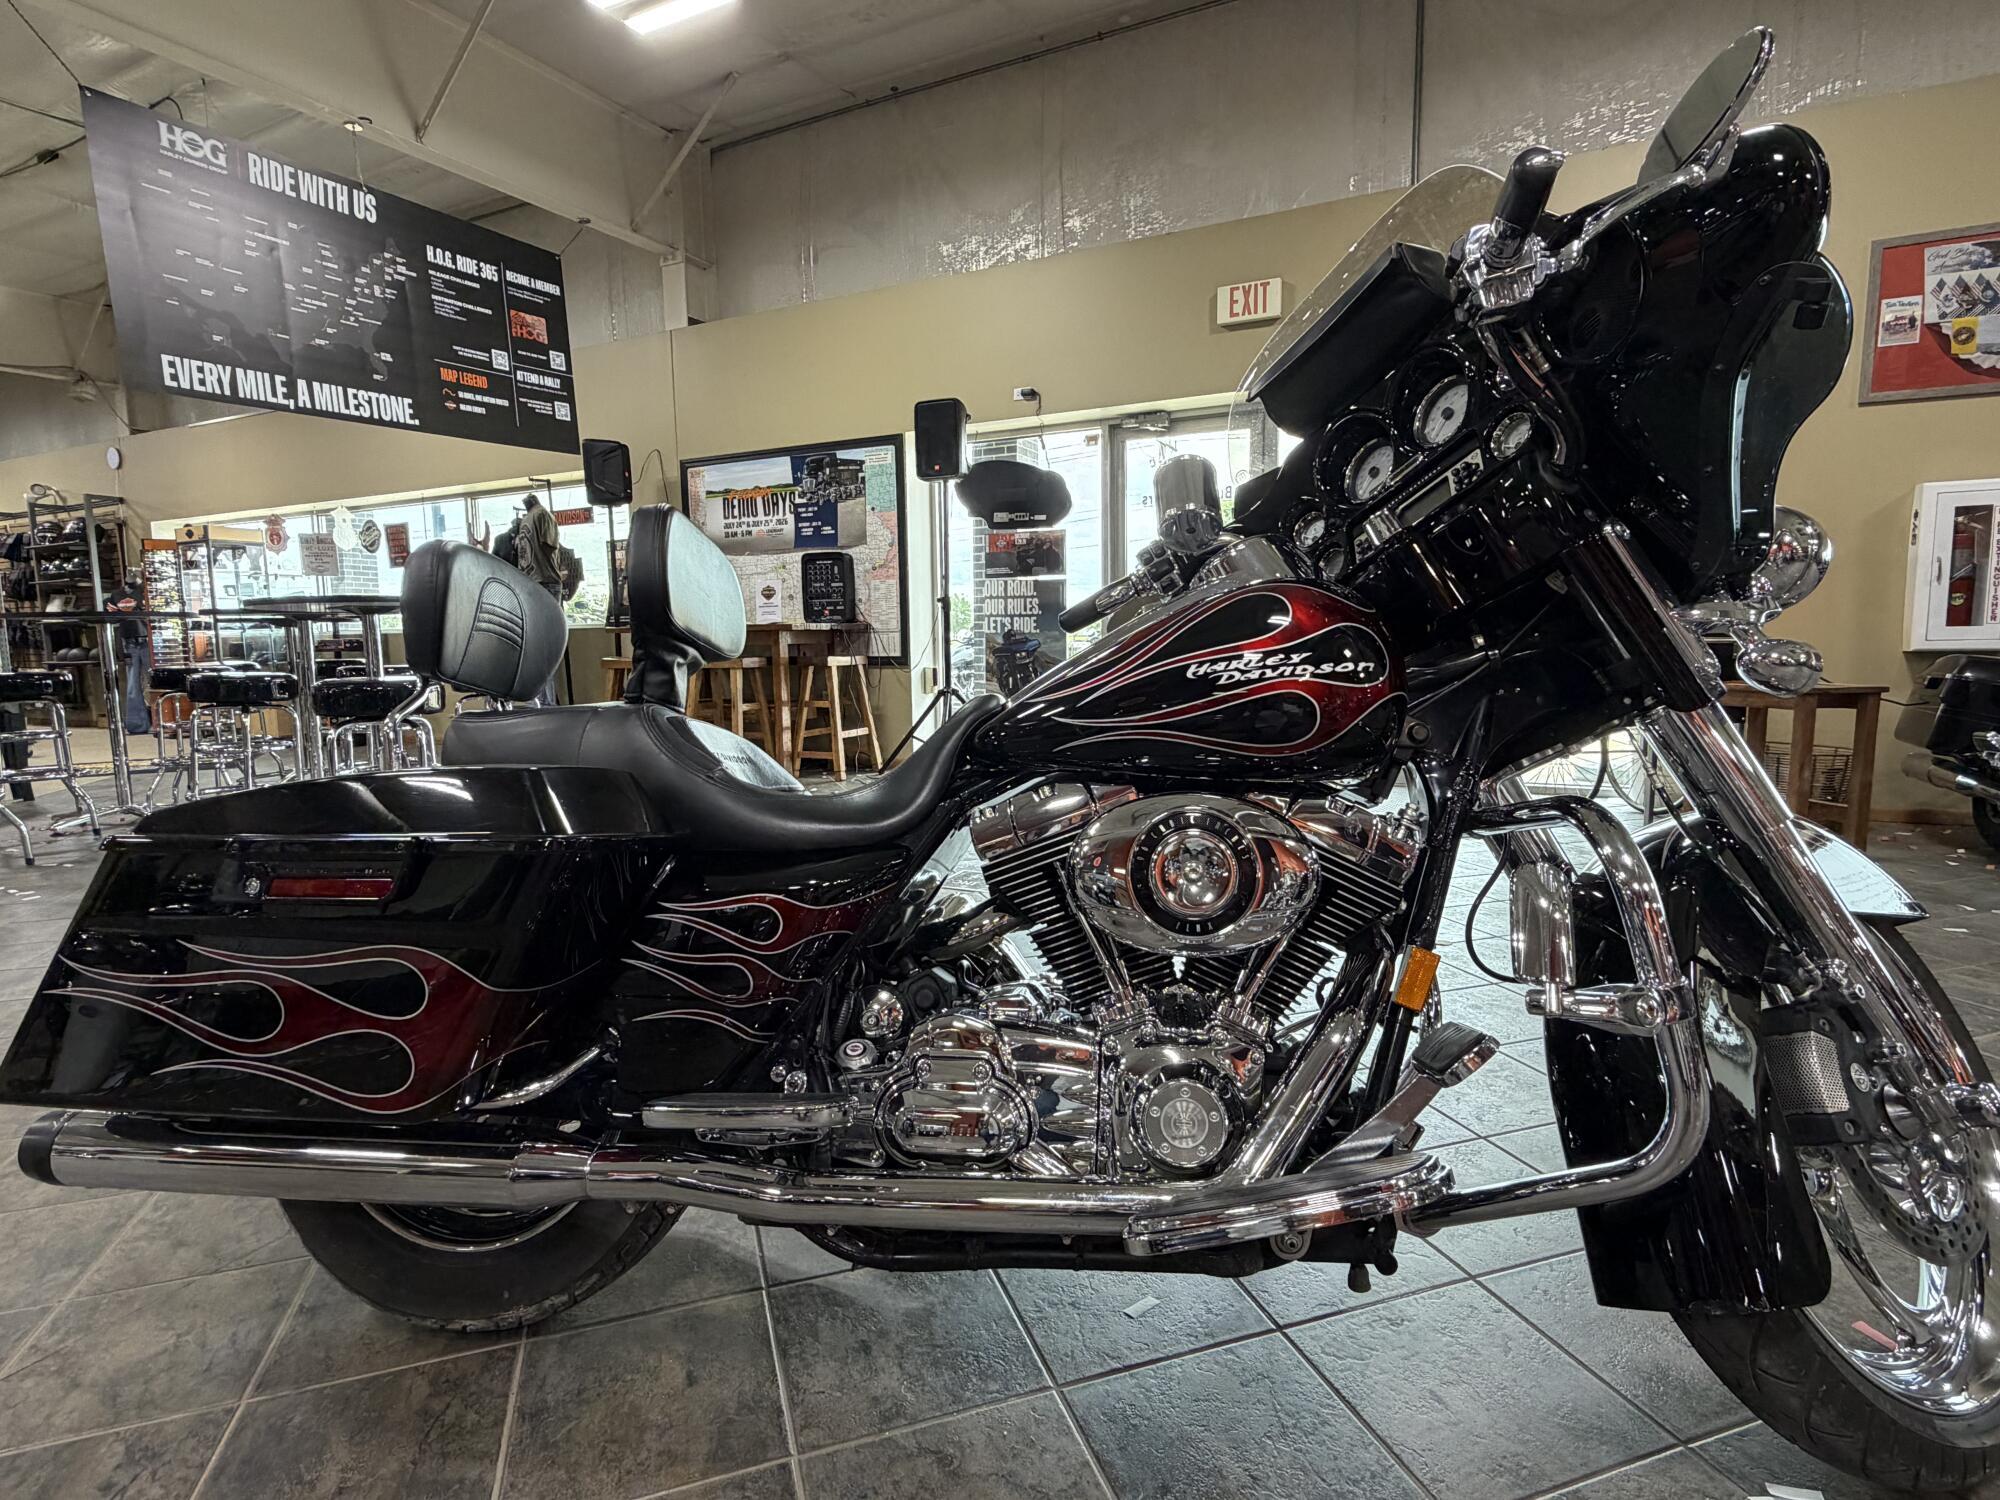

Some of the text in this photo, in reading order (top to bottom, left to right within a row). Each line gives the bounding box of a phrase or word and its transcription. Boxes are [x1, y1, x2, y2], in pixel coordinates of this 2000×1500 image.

[248, 152, 377, 224] RIDE WITH US
[426, 244, 499, 282] H.O.G. RIDE 365
[505, 270, 531, 287] BECOME
[535, 279, 561, 296] MEMBER
[1229, 281, 1270, 318] EXIT
[161, 354, 420, 425] EVERY MILE, A MILESTONE.
[440, 367, 488, 389] MAP LEGEND
[762, 491, 796, 517] DAYS
[985, 580, 1037, 597] OUR ROAD.
[985, 598, 1042, 615] OUR RULES.
[985, 617, 1040, 633] LET'S RIDE.
